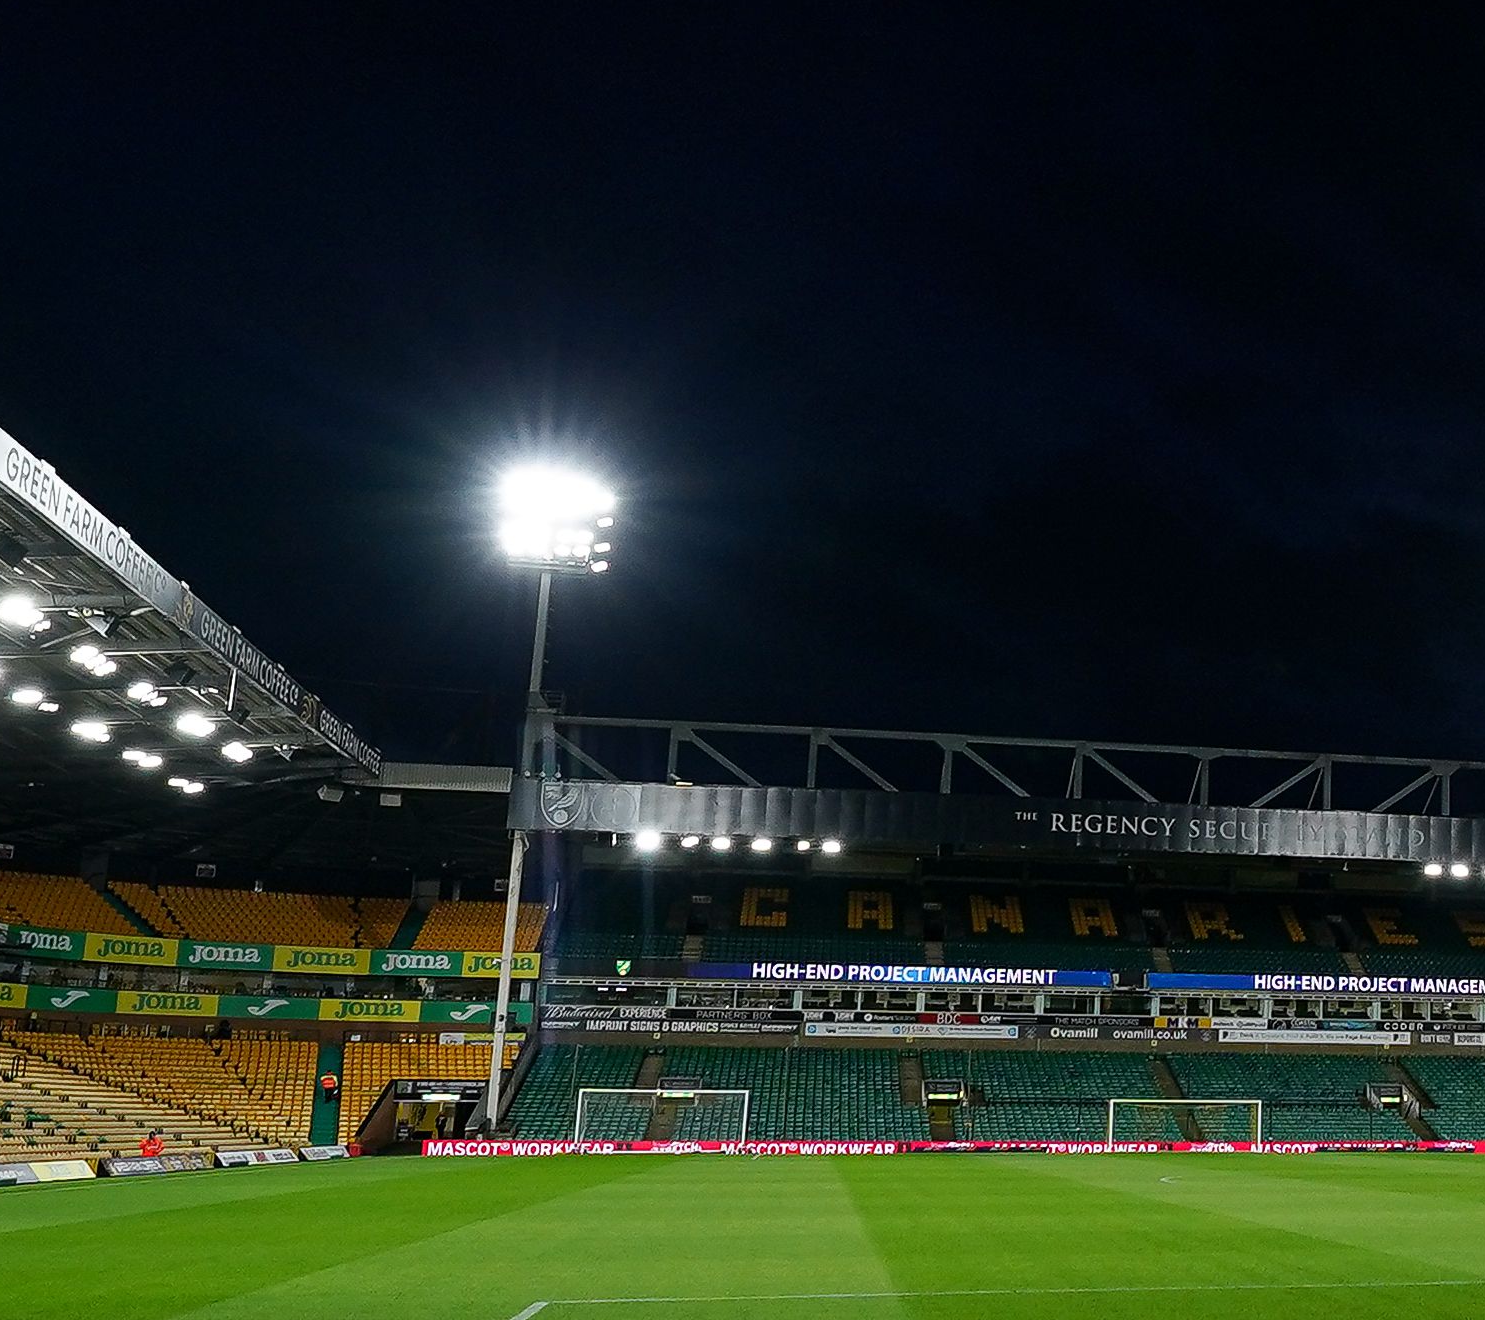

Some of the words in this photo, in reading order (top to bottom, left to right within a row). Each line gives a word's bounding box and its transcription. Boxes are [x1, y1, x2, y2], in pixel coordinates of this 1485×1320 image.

[6, 447, 61, 516] GREEN
[63, 495, 104, 553] FARM
[106, 531, 153, 591] COFFEE
[201, 611, 235, 657] GREEN
[235, 639, 260, 679] FARM
[259, 663, 290, 705] COFFEE
[1015, 811, 1037, 821] THE
[1051, 813, 1176, 836] REGENCY
[753, 963, 844, 980] HIGH-END
[848, 965, 928, 982] PROJECT
[929, 967, 1057, 985] MANAGEMENT
[1255, 974, 1335, 991] HIGH-END
[1339, 976, 1410, 992] PROJECT
[619, 1008, 667, 1019] EXPERIENCE
[752, 1012, 773, 1020] BOX
[937, 1012, 961, 1025] BDC
[586, 1020, 629, 1031] IMPRINT
[630, 1020, 660, 1031] SIGNS
[671, 1021, 719, 1033] GRAPHICS
[1383, 1022, 1424, 1031] CODER
[1050, 1027, 1099, 1038] Ovamill
[1113, 1028, 1188, 1040] ovamill.co.uk
[799, 1143, 896, 1154] WORKWEAR
